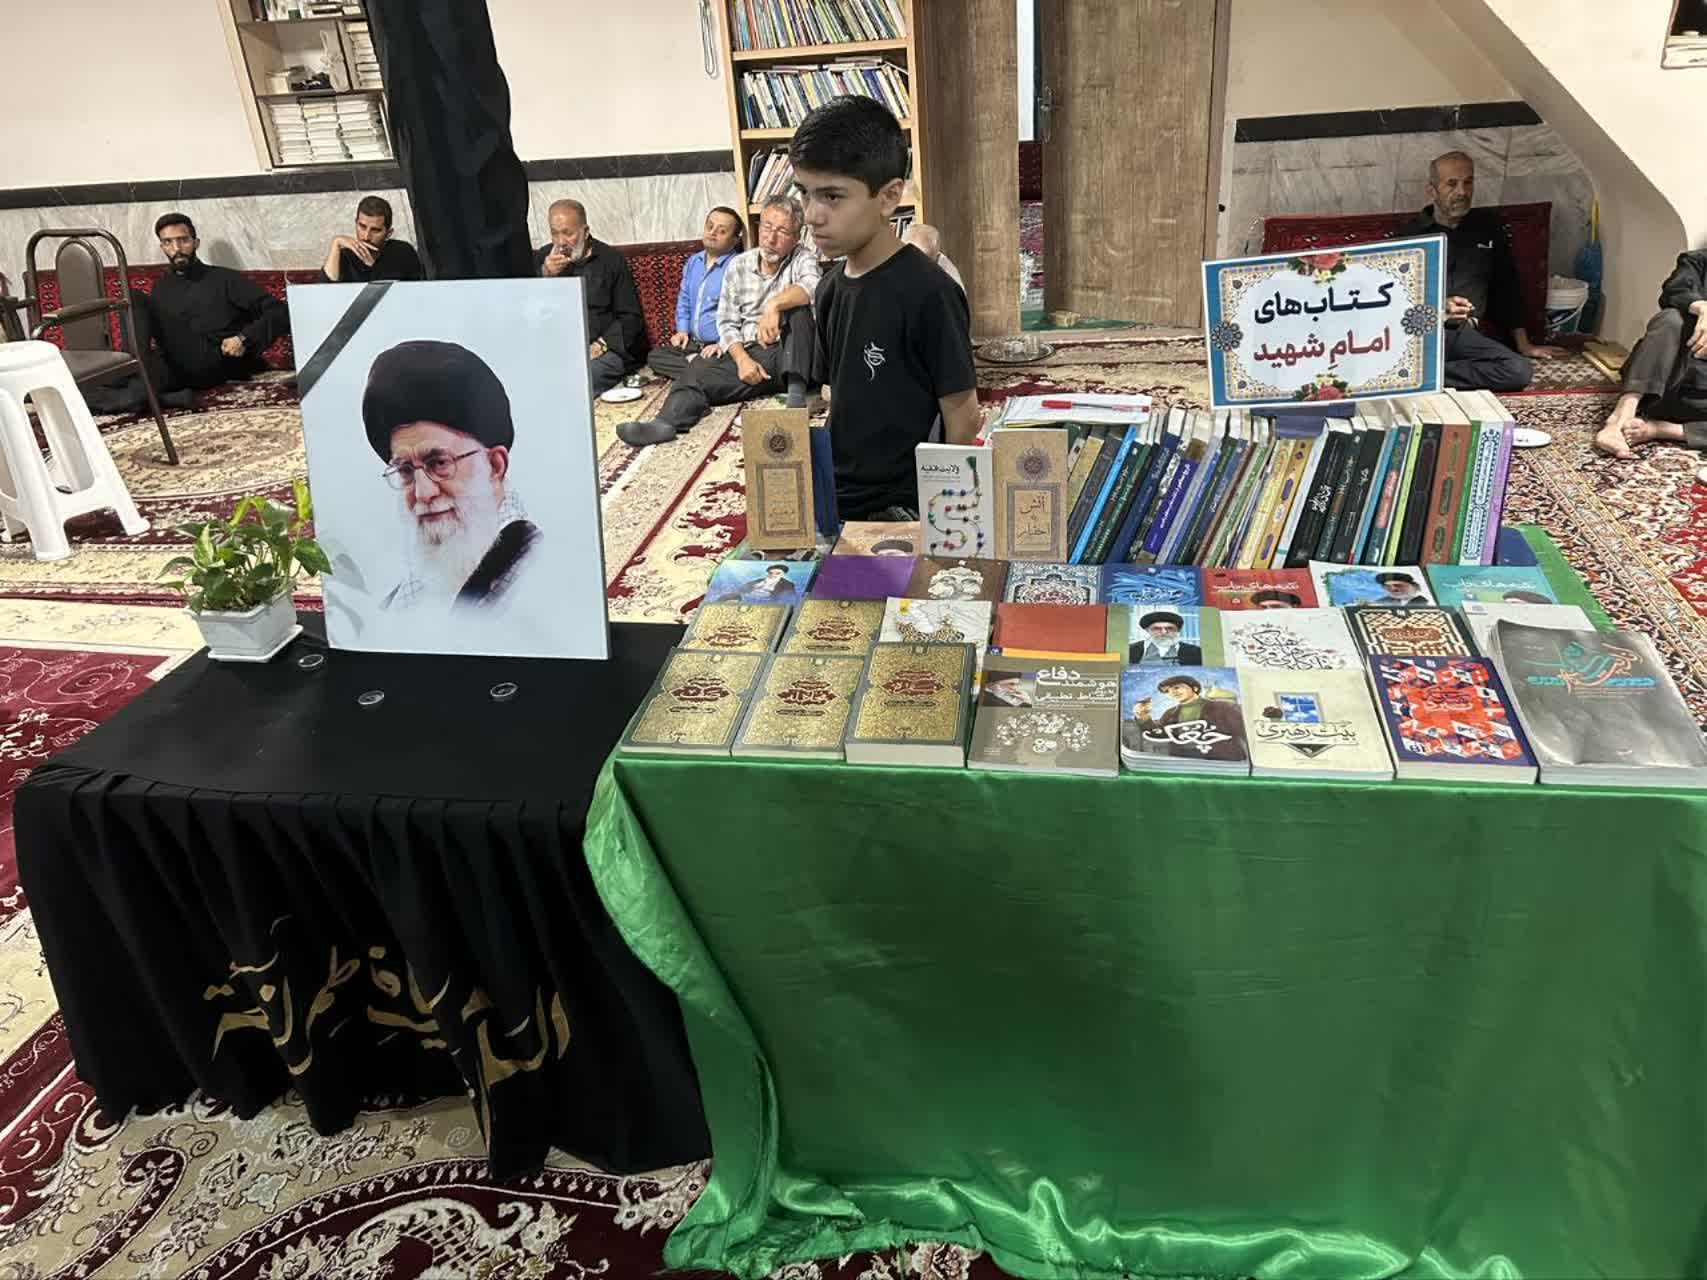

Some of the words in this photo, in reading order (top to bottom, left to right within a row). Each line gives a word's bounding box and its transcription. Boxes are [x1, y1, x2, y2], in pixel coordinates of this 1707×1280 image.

[1253, 332, 1325, 369] شهید
[1036, 666, 1081, 686] دفاع
[1062, 680, 1118, 690] هوشمند
[1255, 723, 1312, 741] رهبری
[1312, 724, 1357, 741] بیت
